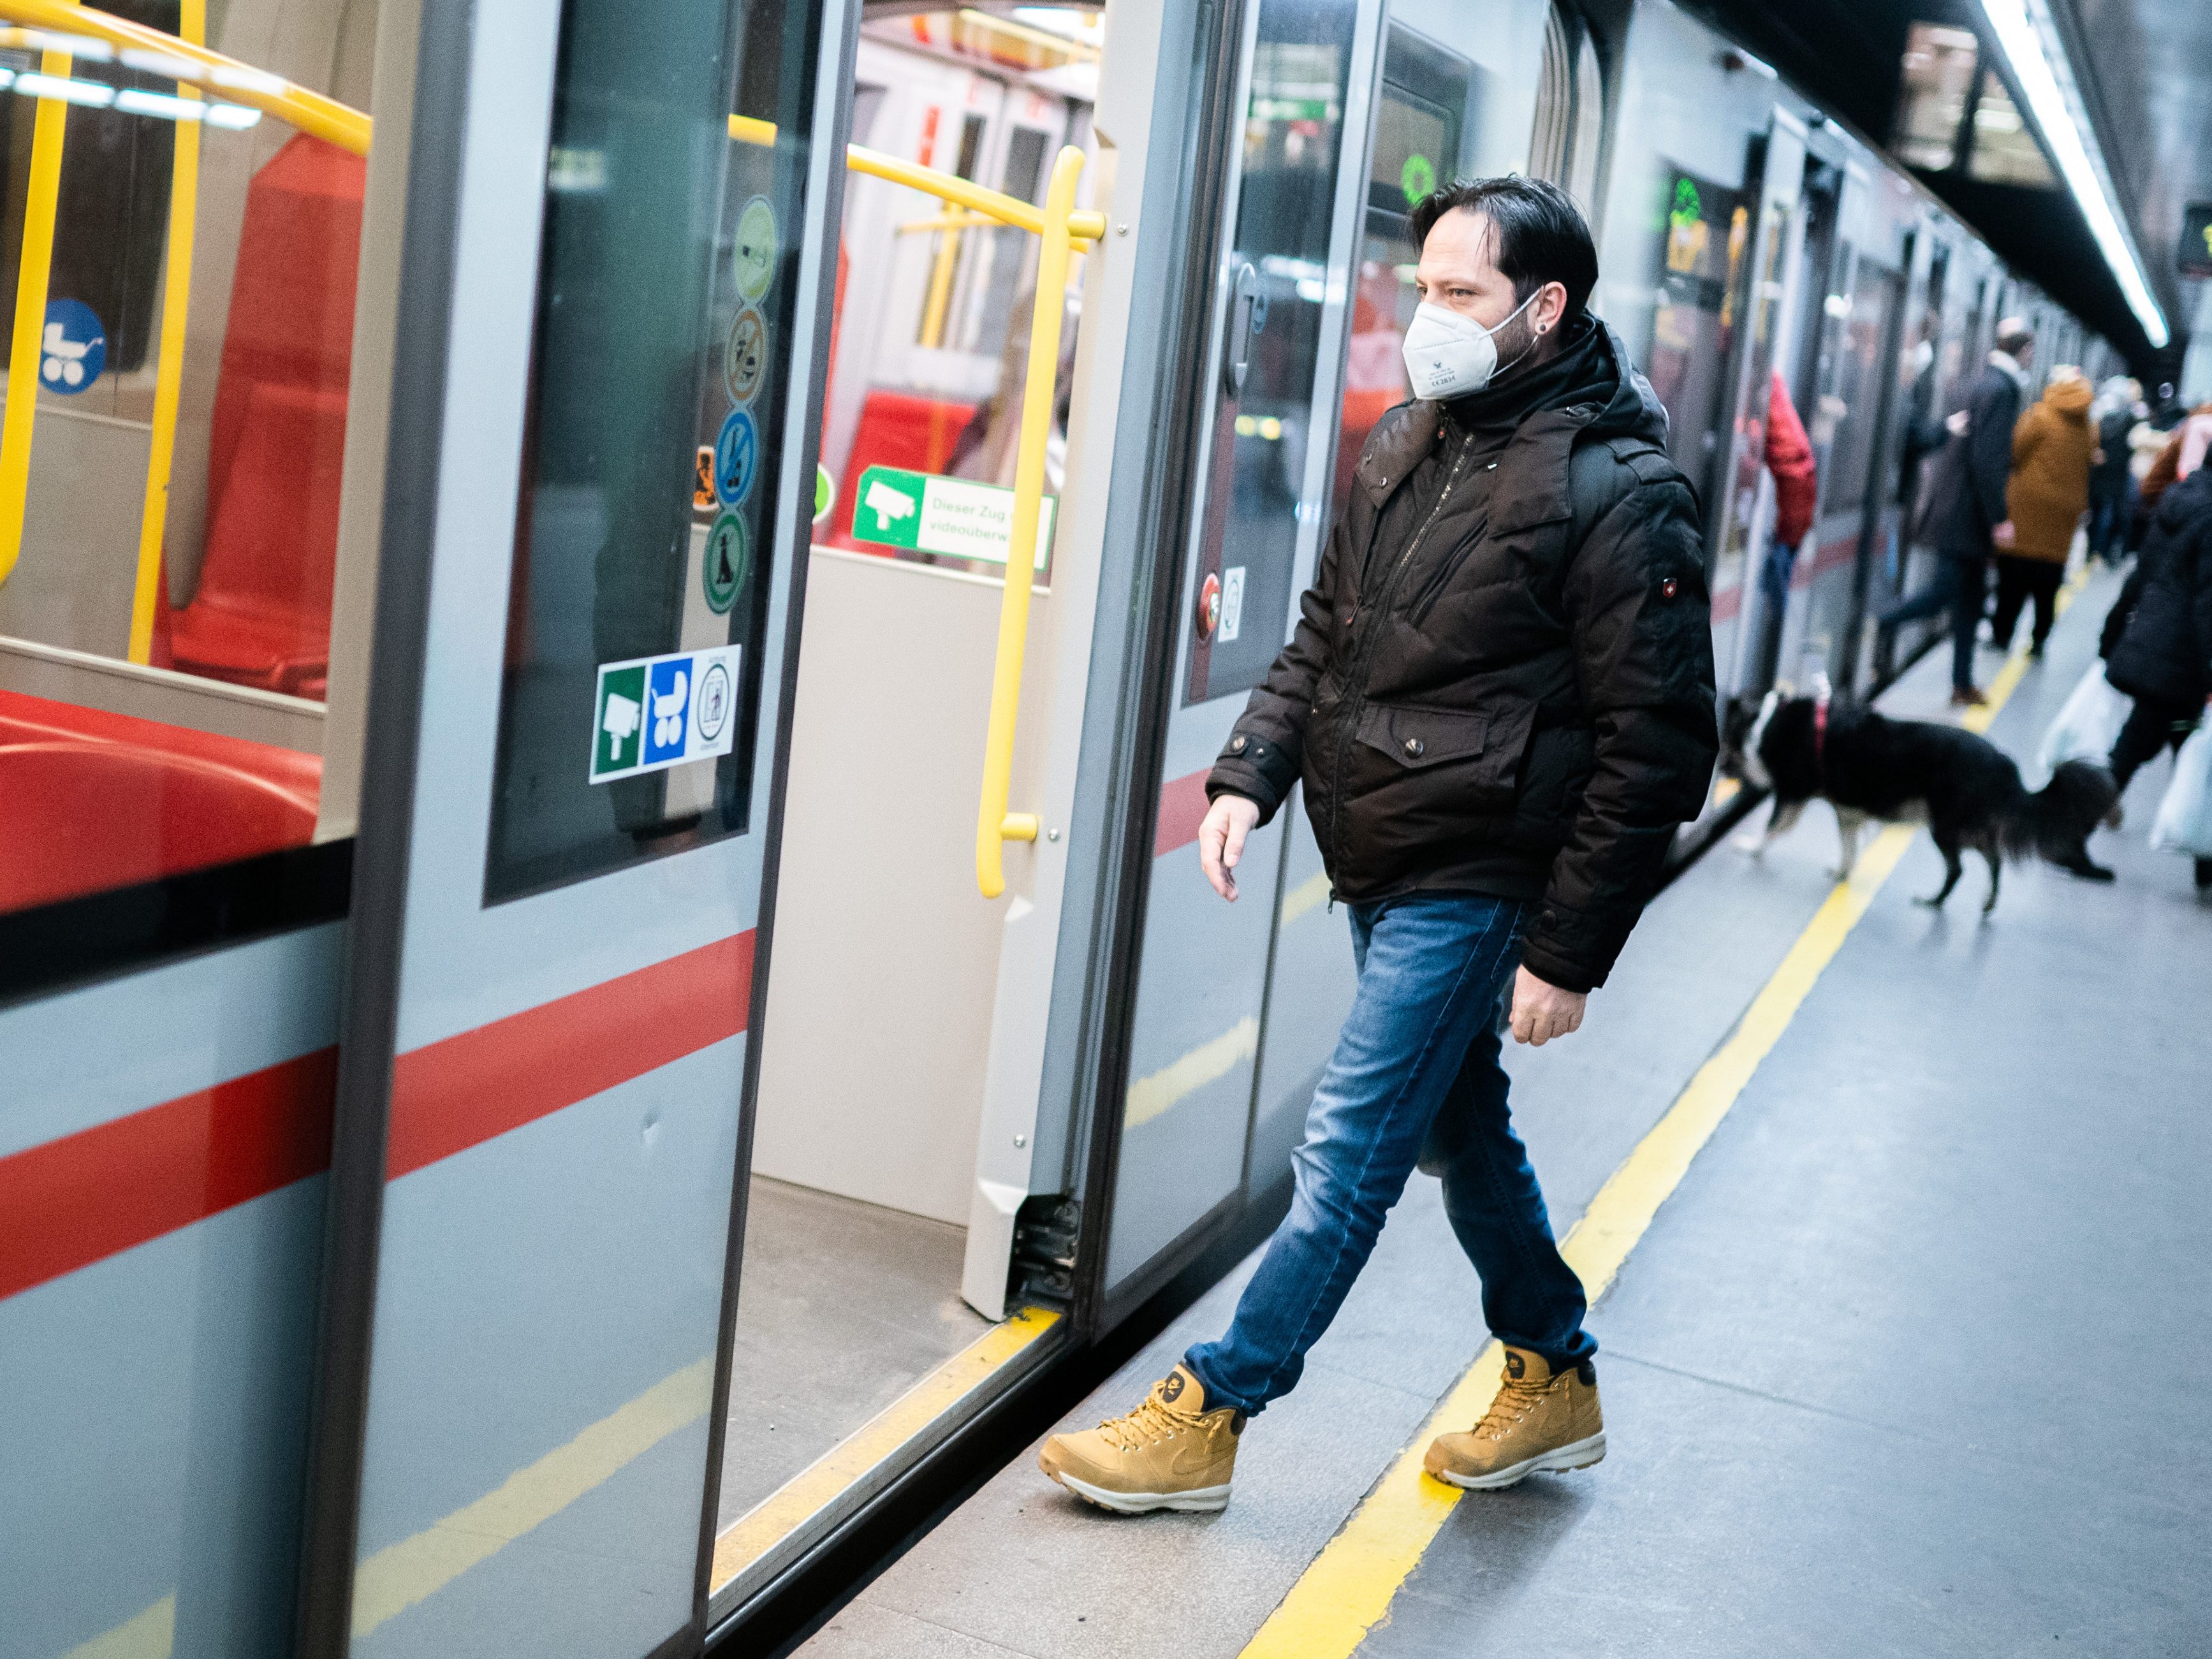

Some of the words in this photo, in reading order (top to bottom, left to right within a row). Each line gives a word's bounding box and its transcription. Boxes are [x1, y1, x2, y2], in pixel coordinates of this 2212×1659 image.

[1440, 375, 1456, 384] 2834
[932, 497, 975, 515] Dieser
[979, 506, 1006, 523] Zug
[929, 520, 1009, 542] videoüberw
